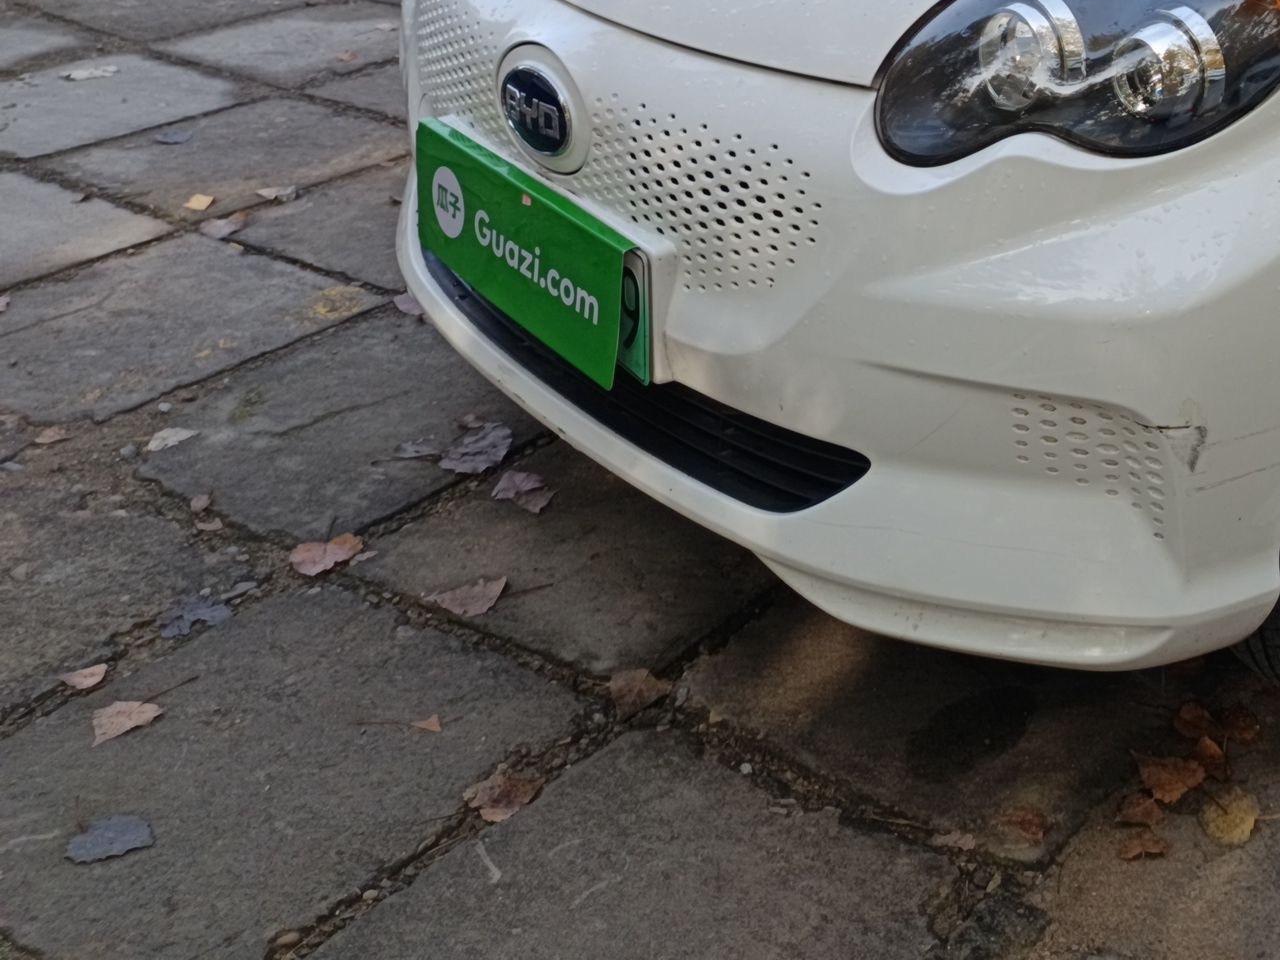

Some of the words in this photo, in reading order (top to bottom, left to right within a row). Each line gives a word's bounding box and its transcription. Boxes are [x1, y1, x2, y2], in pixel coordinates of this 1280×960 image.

[506, 84, 560, 140] BYD
[437, 183, 462, 220] 瓜子
[474, 209, 599, 325] Guazi.com
